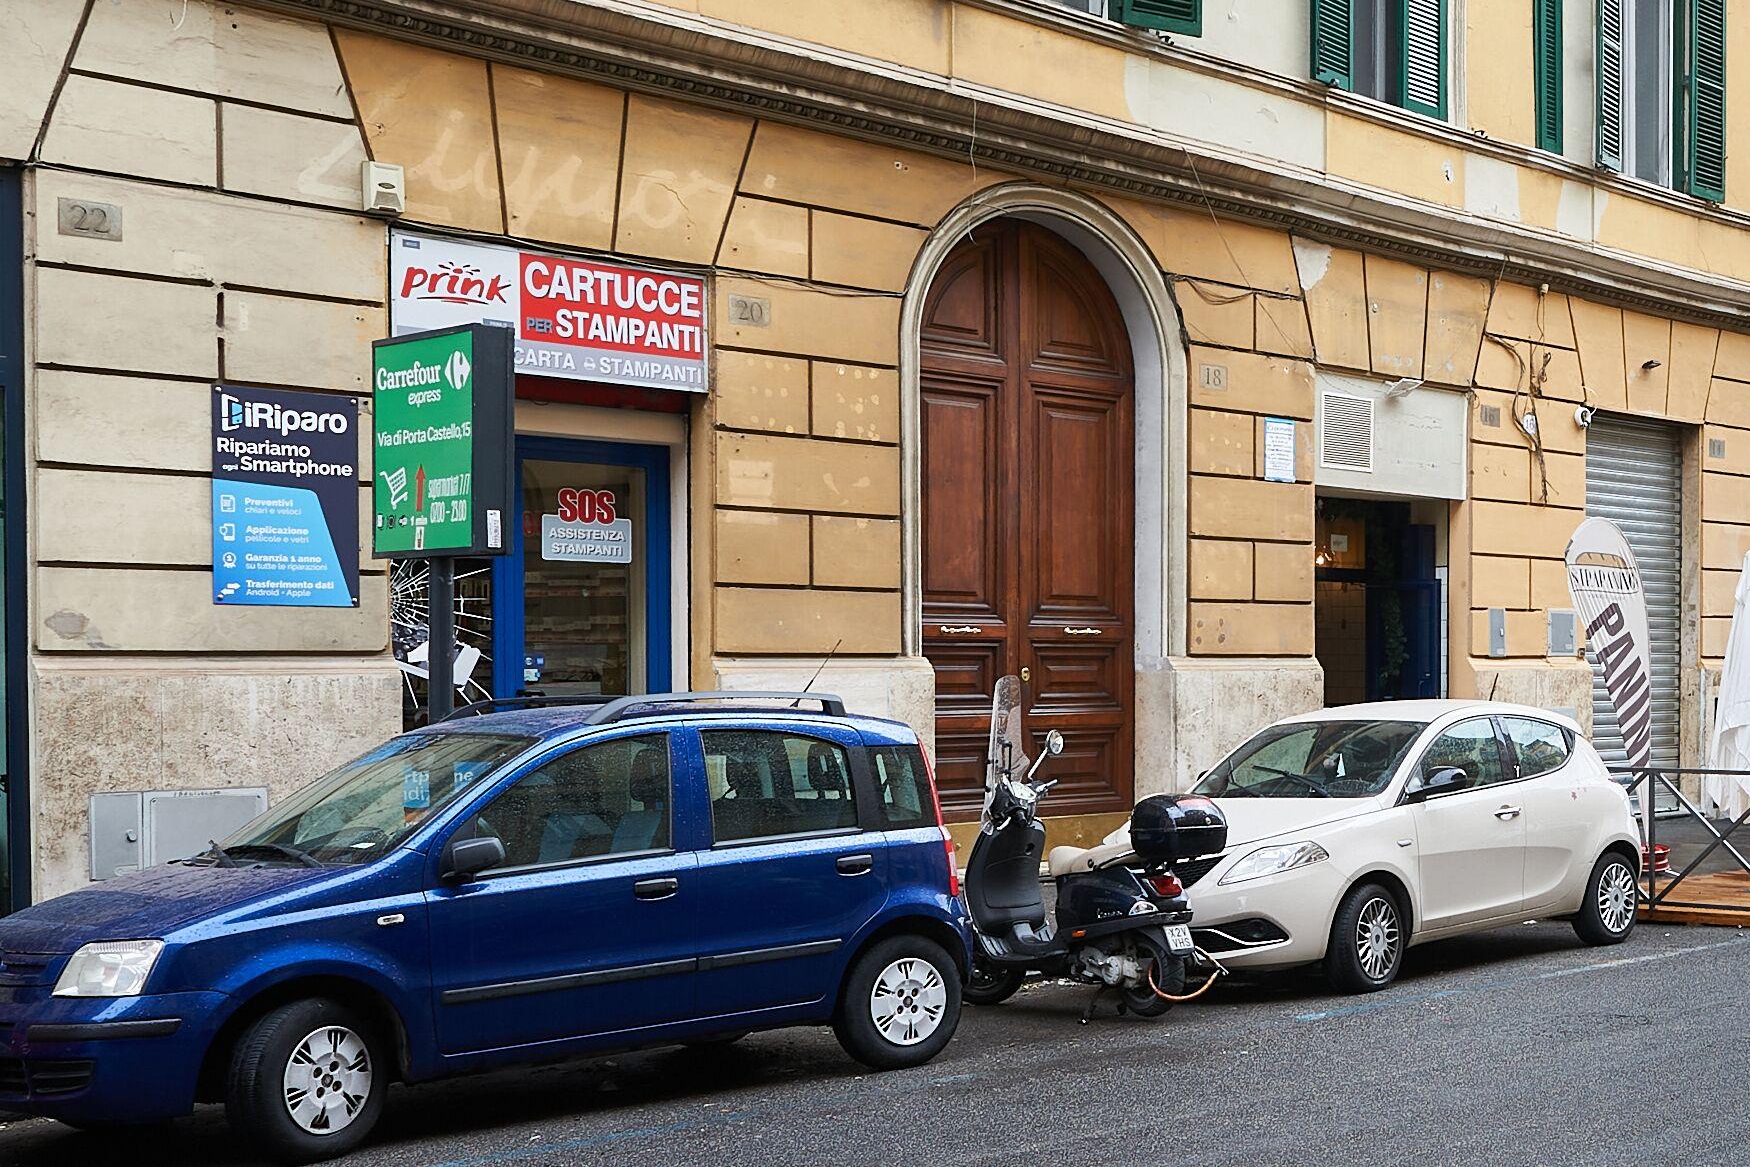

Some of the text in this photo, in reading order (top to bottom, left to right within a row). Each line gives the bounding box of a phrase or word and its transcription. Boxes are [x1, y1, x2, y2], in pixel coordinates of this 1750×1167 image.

[70, 204, 110, 234] 22
[401, 266, 512, 305] prink
[524, 261, 701, 318] CARTUCCE
[736, 299, 763, 322] 20
[526, 308, 701, 353] PER STAMPANTI
[514, 346, 703, 384] CARTA STAMPANTI
[376, 360, 442, 391] Carrefour
[1205, 367, 1222, 387] 18
[407, 388, 442, 408] express
[244, 401, 348, 437] iRiparo
[216, 436, 311, 458] Ripariamo
[377, 432, 393, 447] Via
[393, 430, 402, 446] di
[402, 429, 427, 445] Porta
[221, 455, 354, 478] ogni Smartphone
[244, 497, 294, 508] Preventivi
[244, 507, 268, 515] chiari
[277, 507, 302, 516] veloci
[558, 487, 616, 526] SOS
[244, 525, 310, 536] Applicazione
[549, 527, 627, 542] ASSISTENZA
[244, 553, 289, 563] Garanzia
[297, 556, 323, 564] anno
[551, 542, 624, 557] STAMPANTI
[245, 579, 335, 591] Trasferimento dati
[245, 589, 312, 598] Android Apple
[1169, 927, 1187, 938] X2V
[1172, 937, 1192, 948] VHS
